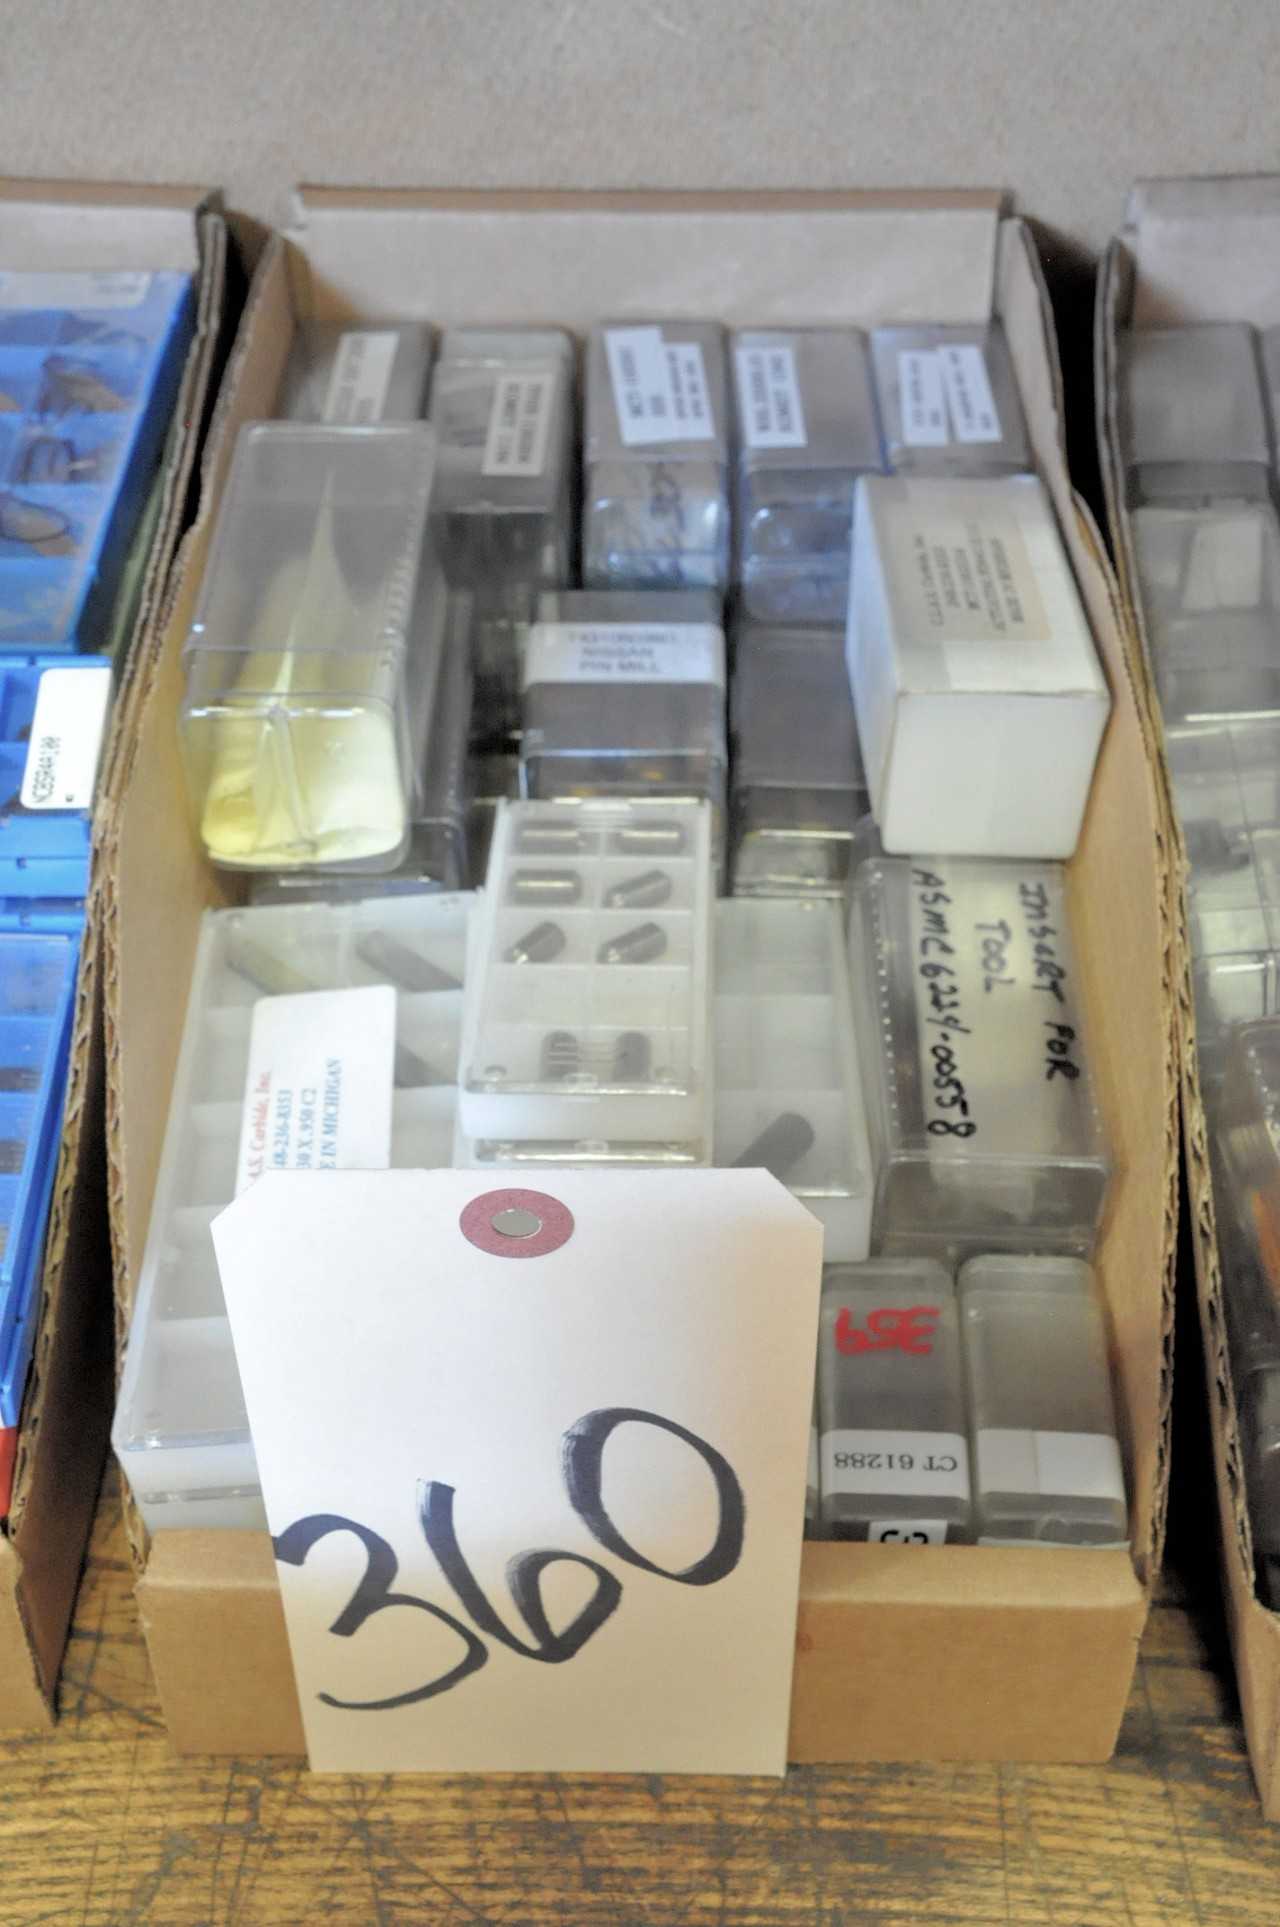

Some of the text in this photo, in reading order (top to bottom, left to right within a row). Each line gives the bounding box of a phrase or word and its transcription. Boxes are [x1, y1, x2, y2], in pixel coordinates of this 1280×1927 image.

[975, 920, 1015, 993] TOOL
[1020, 883, 1081, 1082] INSERT FOR
[322, 1057, 342, 1136] MICHIGAN
[296, 1152, 312, 1169] 30
[320, 1140, 337, 1157] IN
[832, 1452, 959, 1473] CT 61288
[272, 1407, 746, 1711] 360
